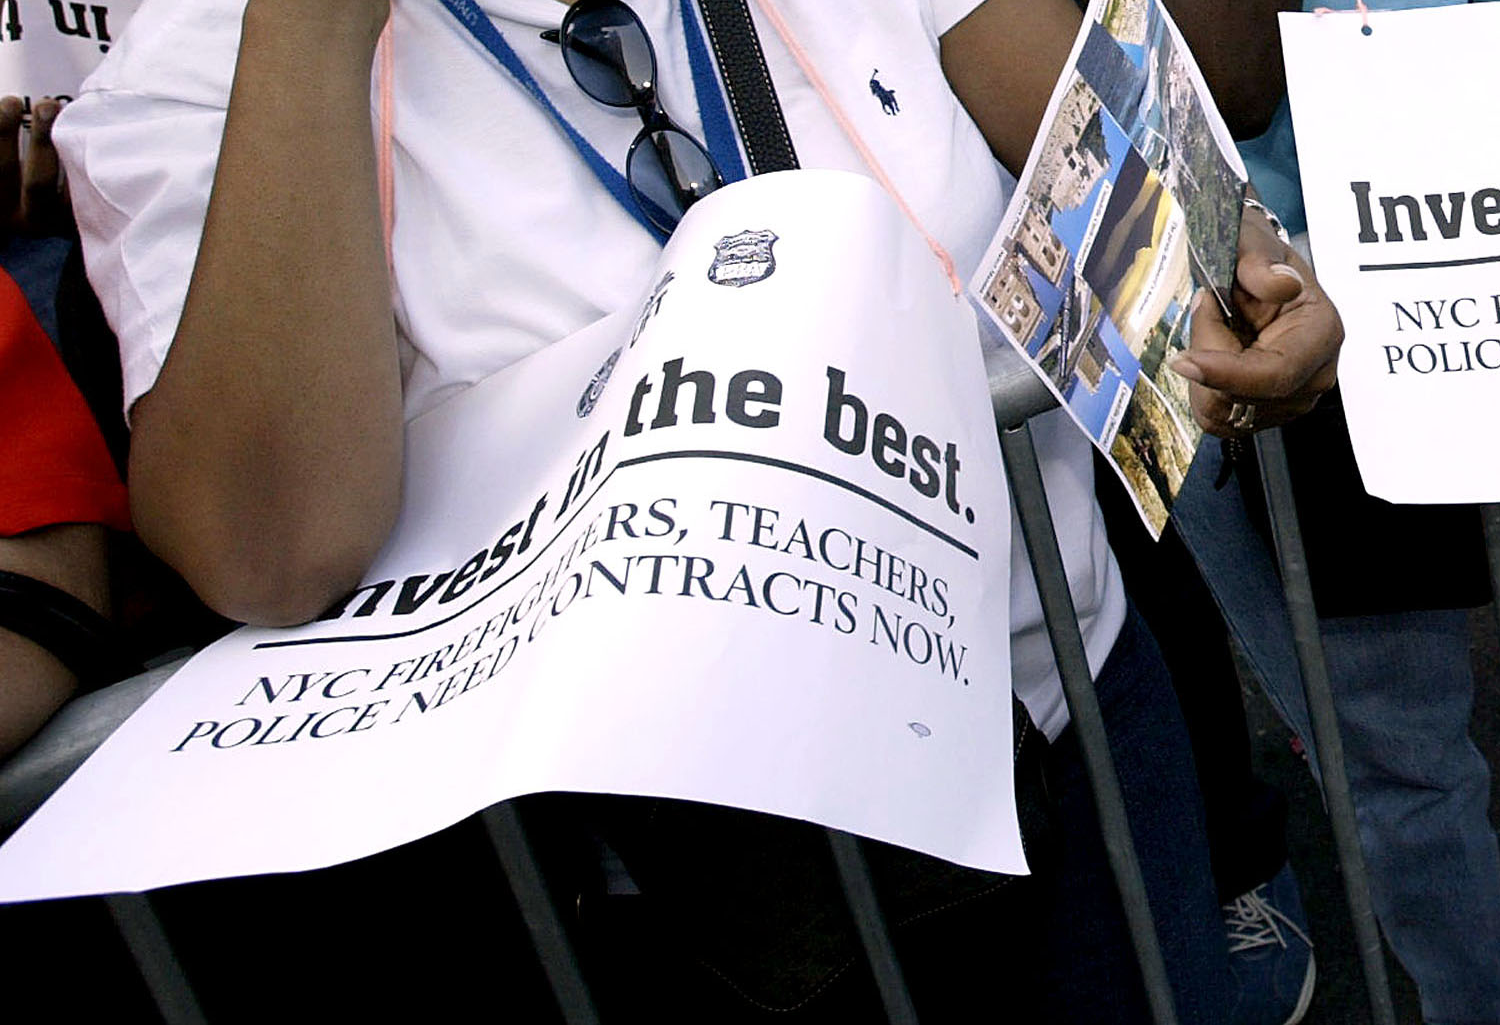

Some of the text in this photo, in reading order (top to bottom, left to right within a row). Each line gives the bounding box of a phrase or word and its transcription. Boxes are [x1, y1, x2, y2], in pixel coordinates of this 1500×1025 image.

[1392, 297, 1481, 332] NYC
[315, 492, 548, 623] nvest
[555, 429, 610, 524] in
[623, 357, 783, 437] the
[823, 365, 975, 524] best.
[169, 554, 970, 753] POLICE NEED CONTRACTS NOW.
[235, 497, 957, 706] NYC FIREFIGHTERS, TEACHERS,
